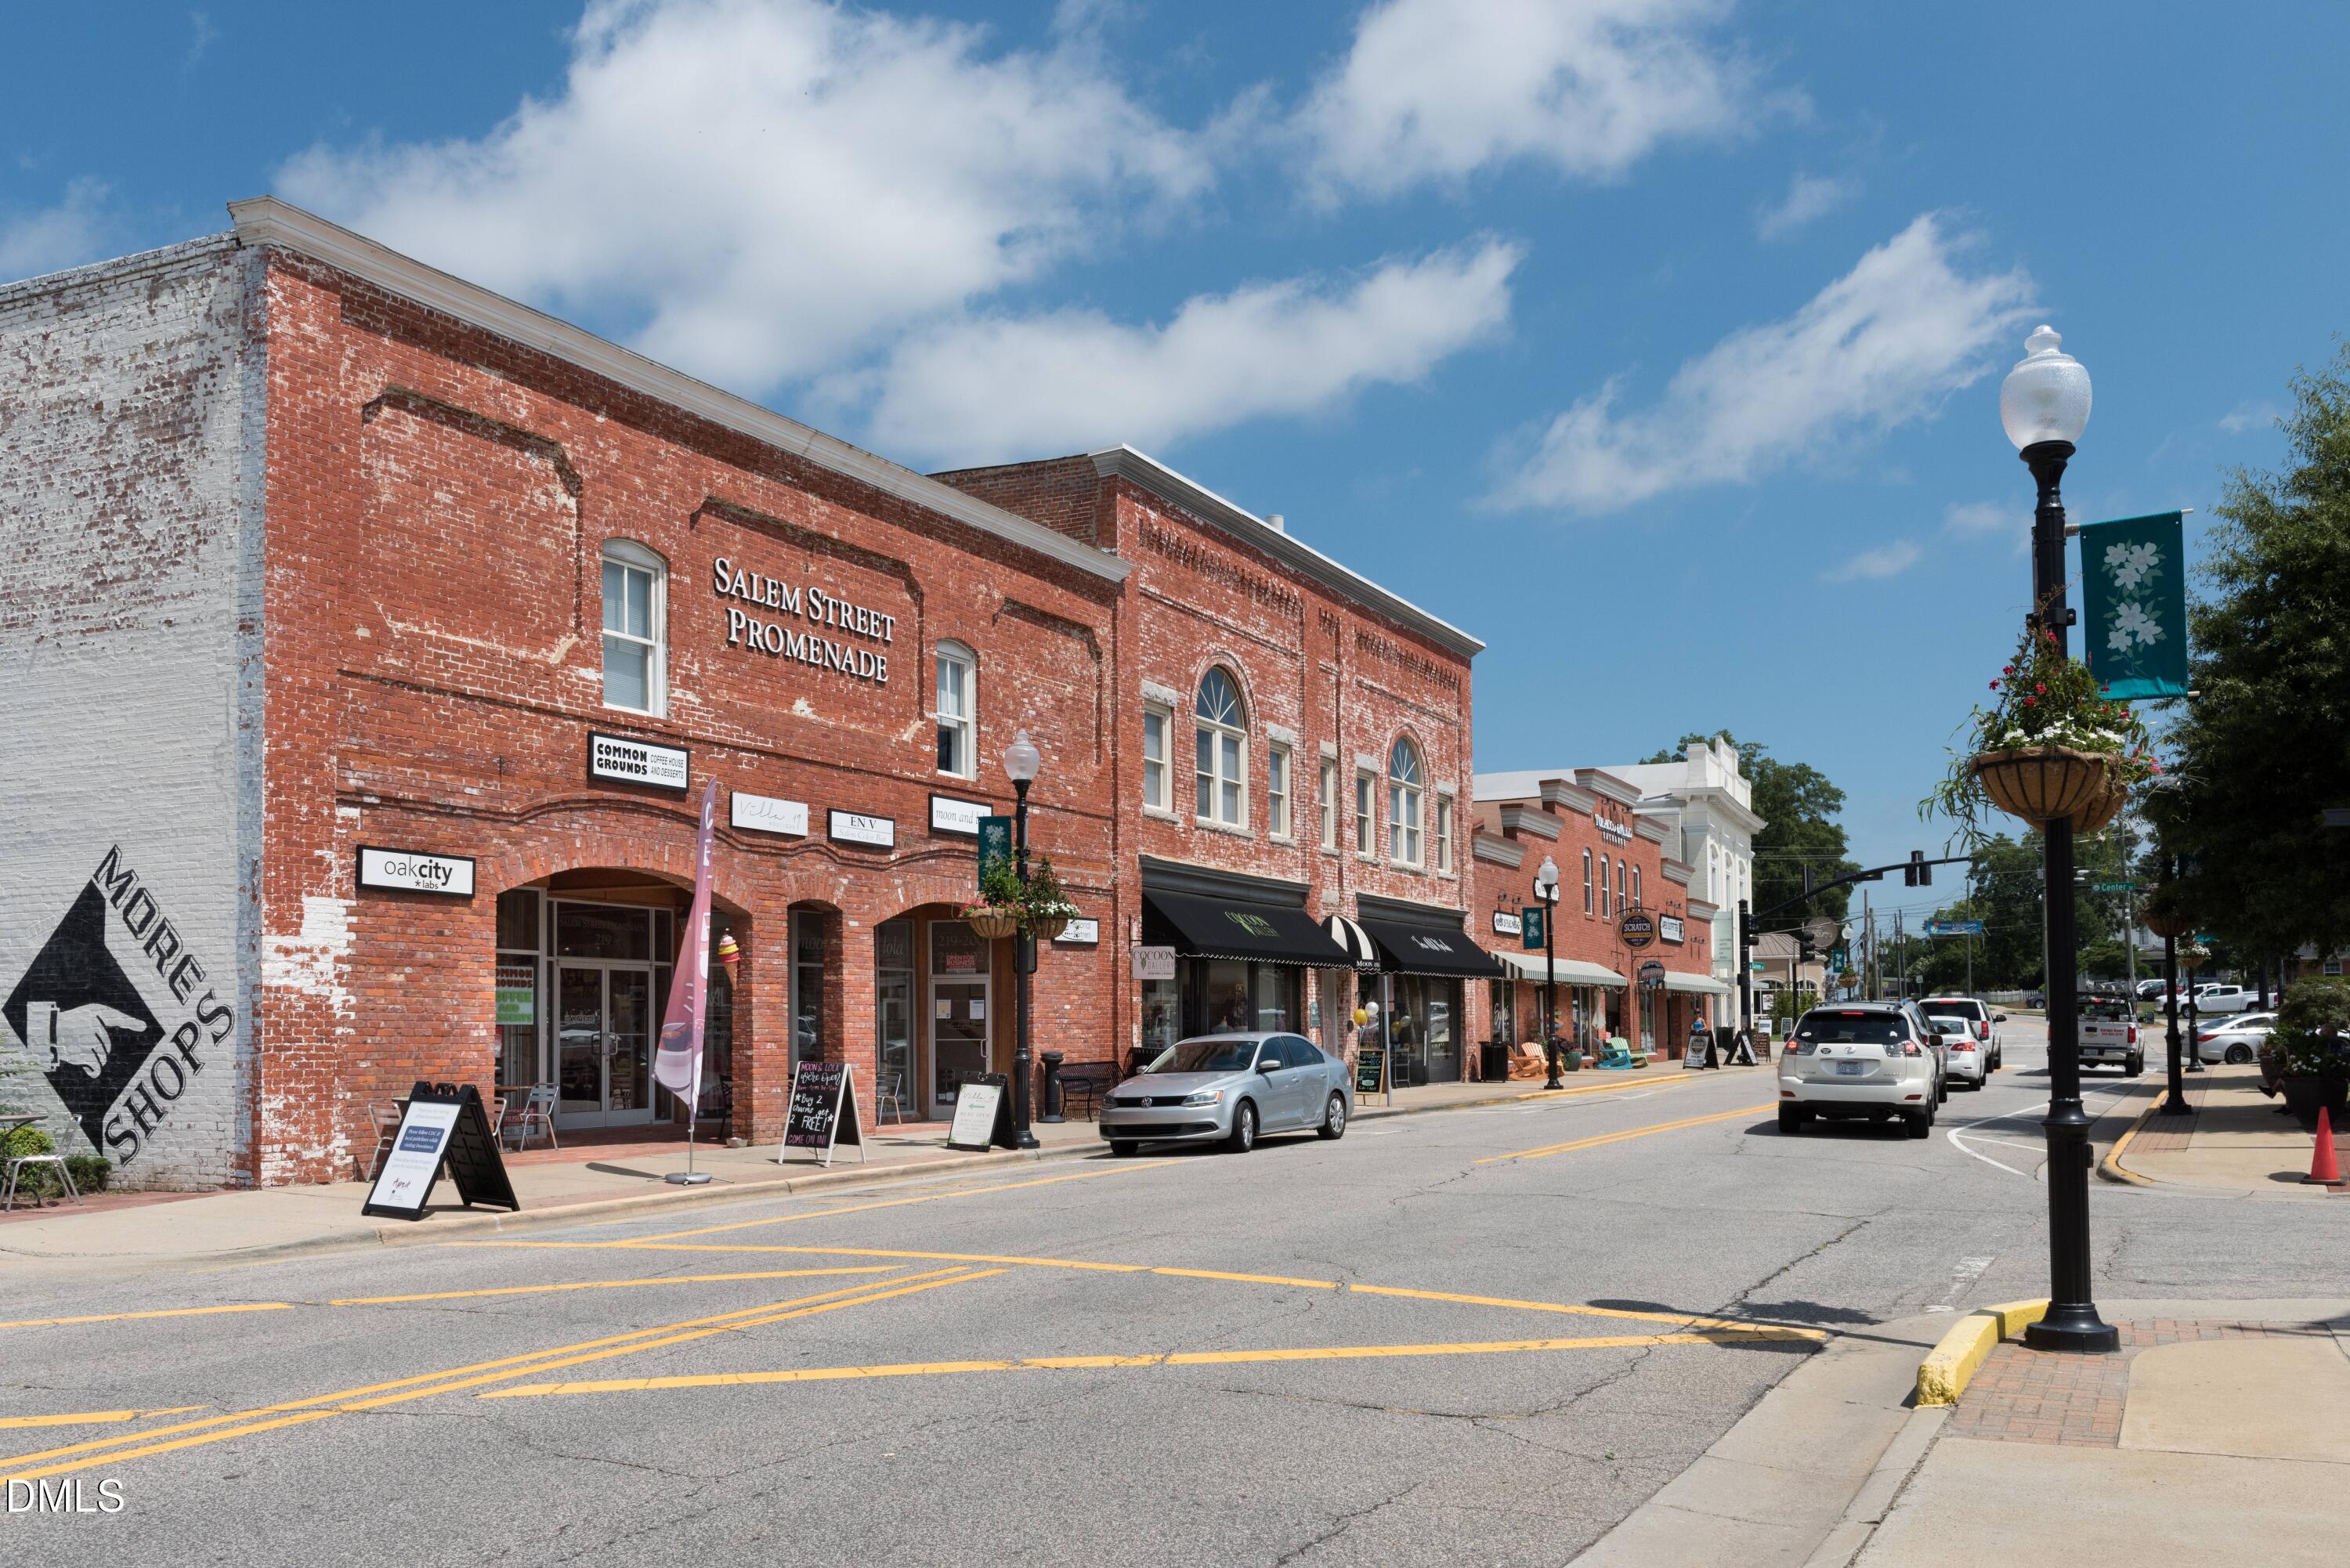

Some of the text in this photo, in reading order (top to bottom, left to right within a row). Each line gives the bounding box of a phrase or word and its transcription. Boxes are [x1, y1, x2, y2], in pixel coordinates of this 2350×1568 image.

[714, 557, 895, 642] SALEM STREET
[726, 606, 888, 682] PROMENADE
[597, 743, 647, 762] COMMON
[597, 757, 647, 775] GROUNDS
[650, 754, 684, 768] COFFEE HOUSE
[651, 767, 684, 779] AND DESSERTS
[936, 810, 956, 822] moon
[959, 811, 973, 824] and
[384, 856, 453, 887] oakcity
[92, 844, 207, 1006] MORE
[1624, 923, 1650, 932] SCRATCH
[883, 935, 903, 956] lola
[1133, 950, 1173, 960] COCOON
[495, 967, 533, 978] OMMON
[1148, 961, 1173, 970] GALLERY
[495, 979, 533, 988] ROUNDS
[495, 991, 533, 1003] OFFEE
[801, 1063, 818, 1071] MOON
[104, 987, 235, 1168] SHOPS
[821, 1072, 841, 1086] Open
[801, 1093, 822, 1107] Buy 2
[793, 1104, 830, 1119] charms get
[790, 1115, 827, 1133] 2 FREE!
[788, 1134, 827, 1144] COME ON IN!
